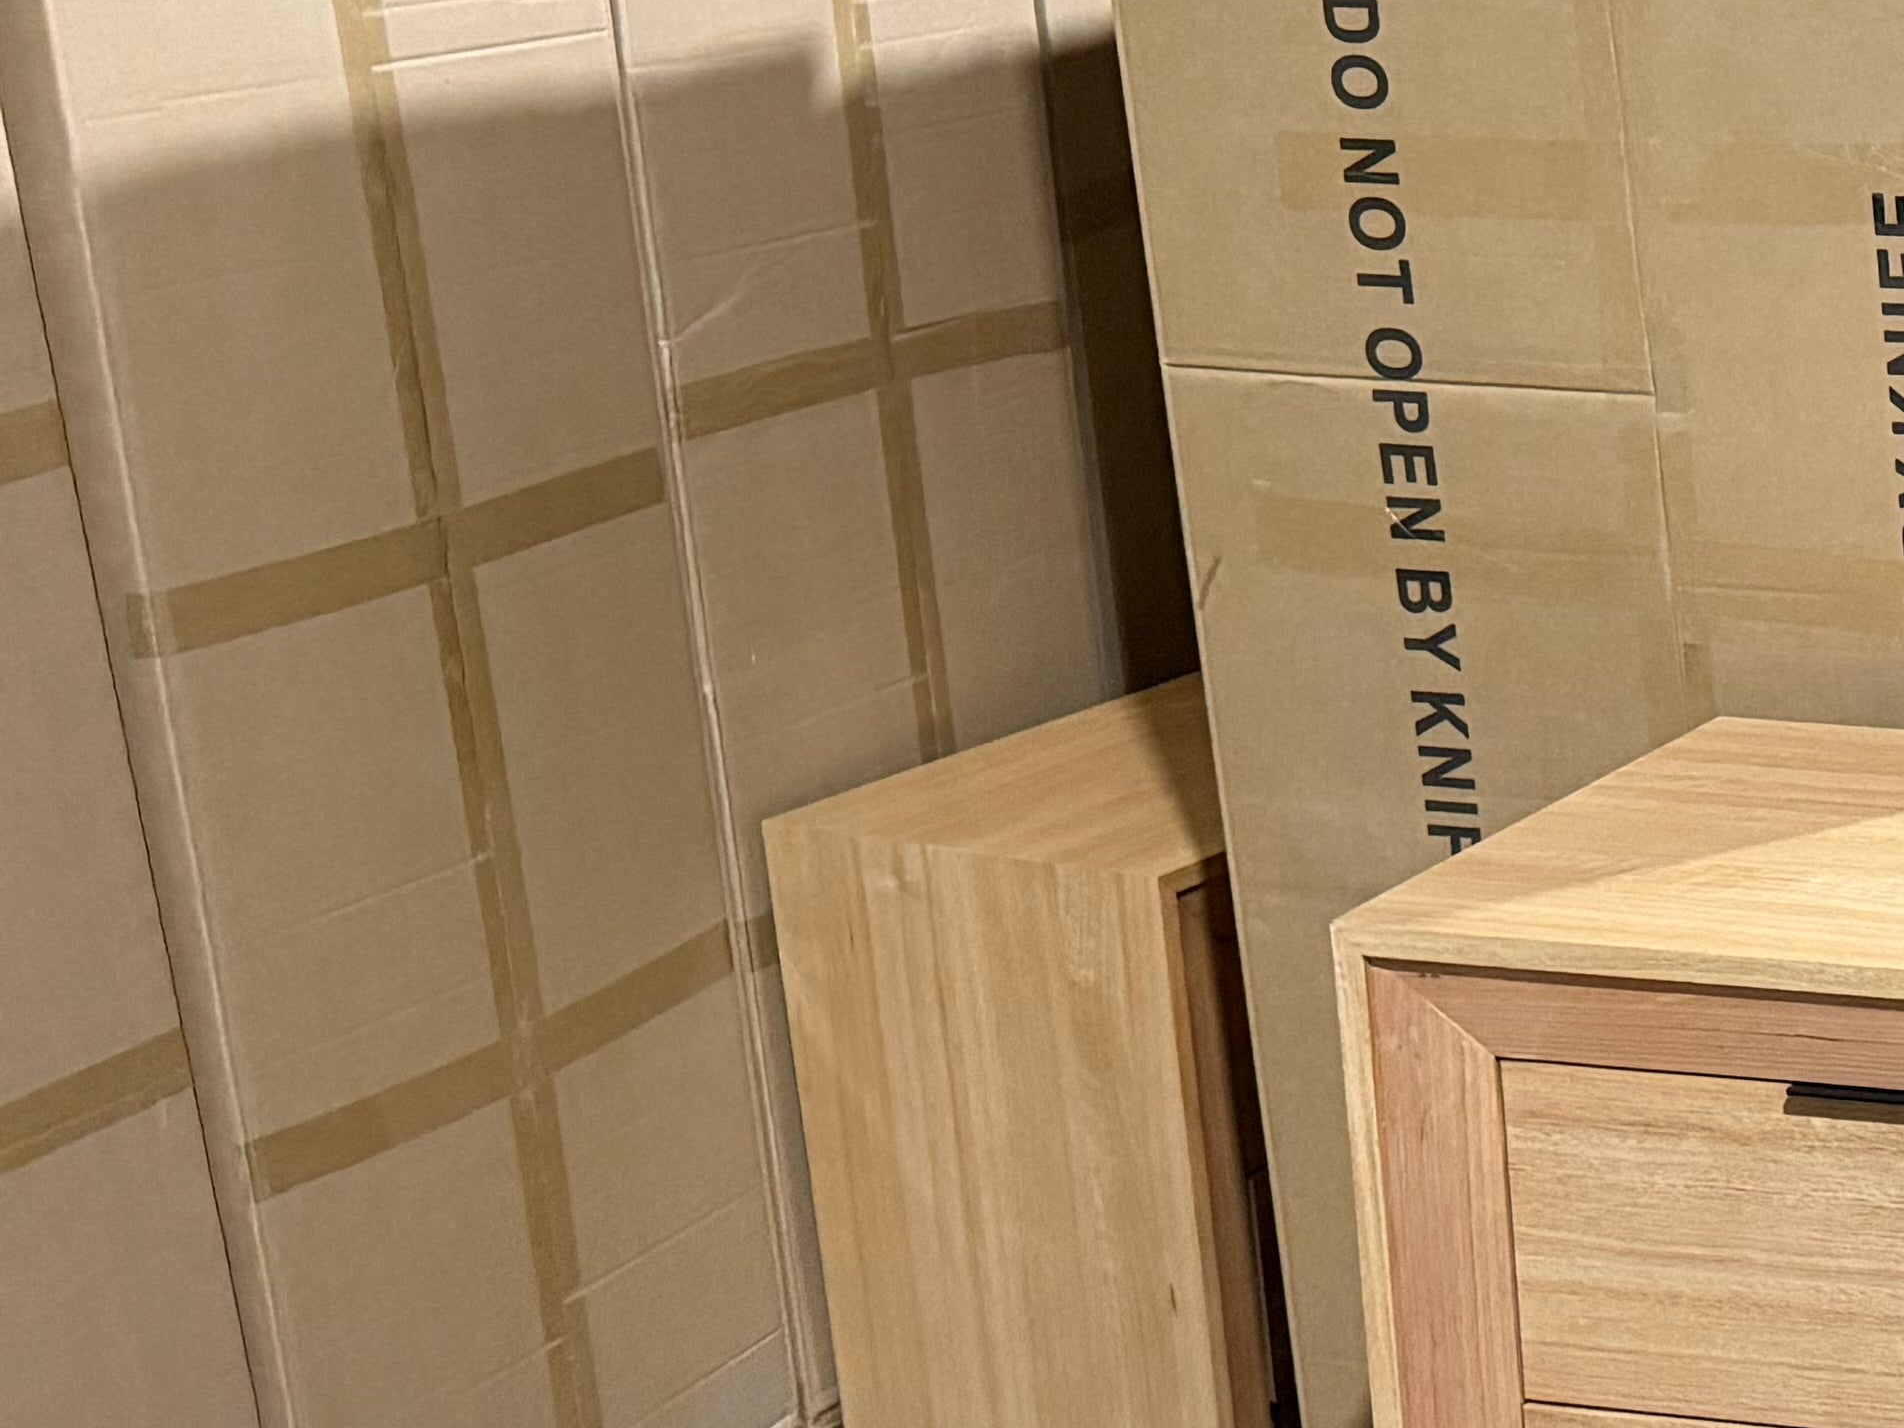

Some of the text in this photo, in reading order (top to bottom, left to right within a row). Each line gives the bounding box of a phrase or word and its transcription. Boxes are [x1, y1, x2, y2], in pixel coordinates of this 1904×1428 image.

[1339, 136, 1415, 306] NOT
[1364, 326, 1446, 543] OPEN
[1394, 567, 1462, 673] BY
